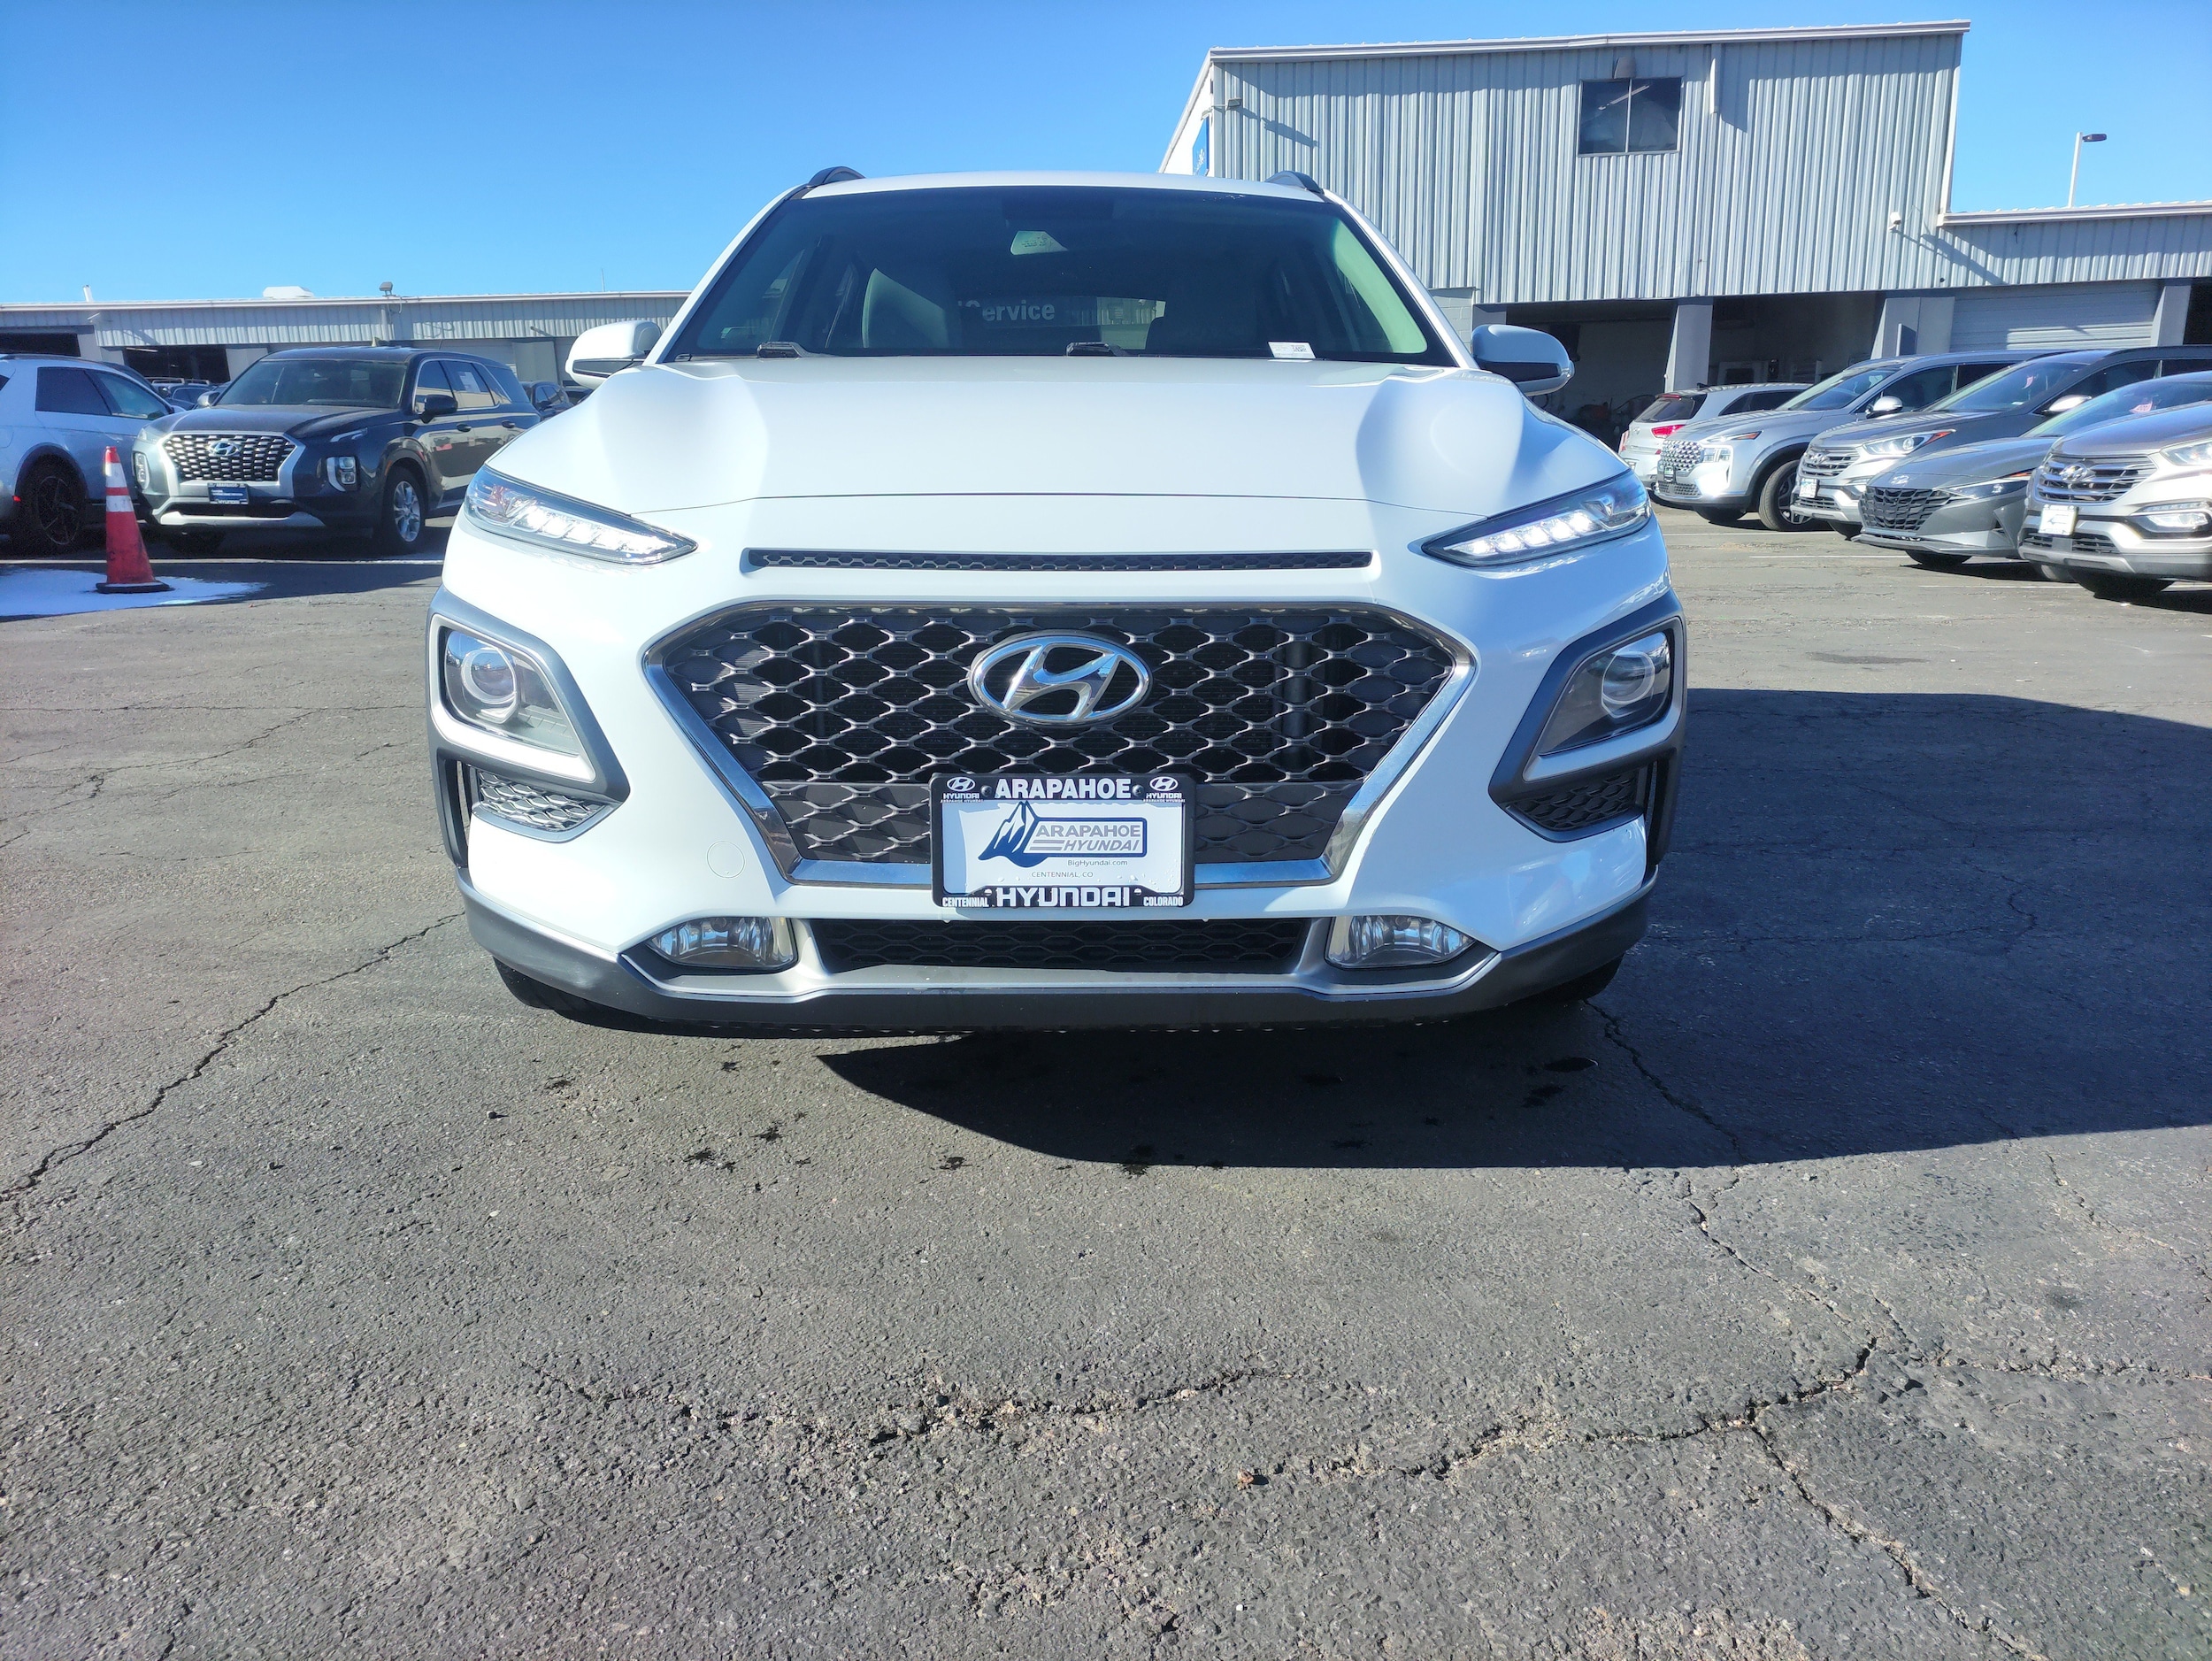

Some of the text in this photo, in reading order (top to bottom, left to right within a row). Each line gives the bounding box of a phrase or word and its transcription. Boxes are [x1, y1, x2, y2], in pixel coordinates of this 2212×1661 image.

[995, 778, 1132, 799] ARAPAHOE
[1035, 825, 1141, 837] ARAPAHOE
[1064, 840, 1140, 851] HYUNDAI
[941, 896, 989, 907] CENTENNIAL
[996, 887, 1130, 907] HYUNDAI
[1143, 896, 1184, 907] COLORADO
